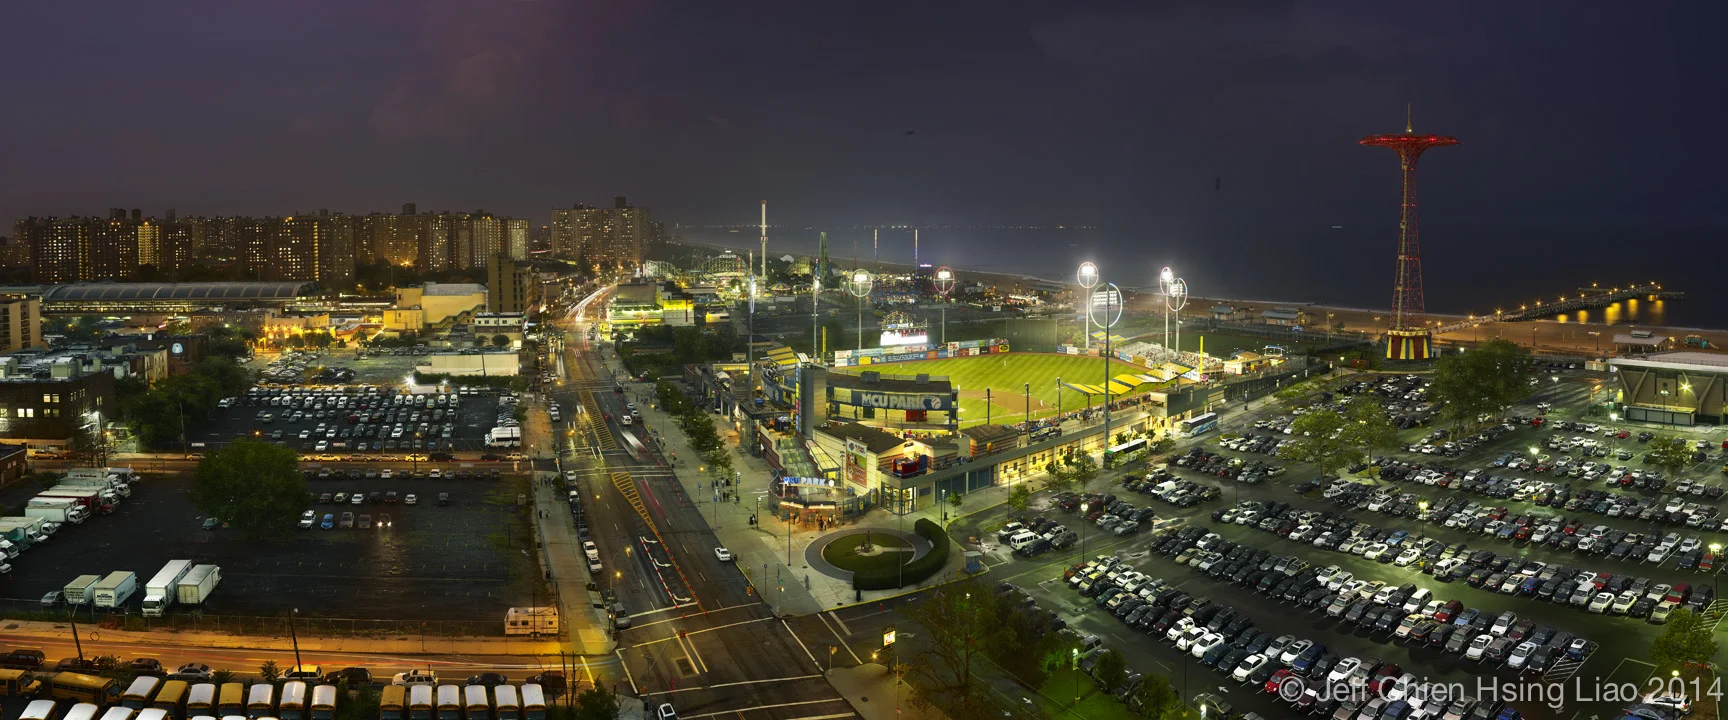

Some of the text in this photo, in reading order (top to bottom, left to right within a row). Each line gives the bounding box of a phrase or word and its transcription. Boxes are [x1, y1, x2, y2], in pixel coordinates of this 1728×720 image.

[861, 393, 927, 410] MCU PARK
[800, 476, 826, 487] PARK
